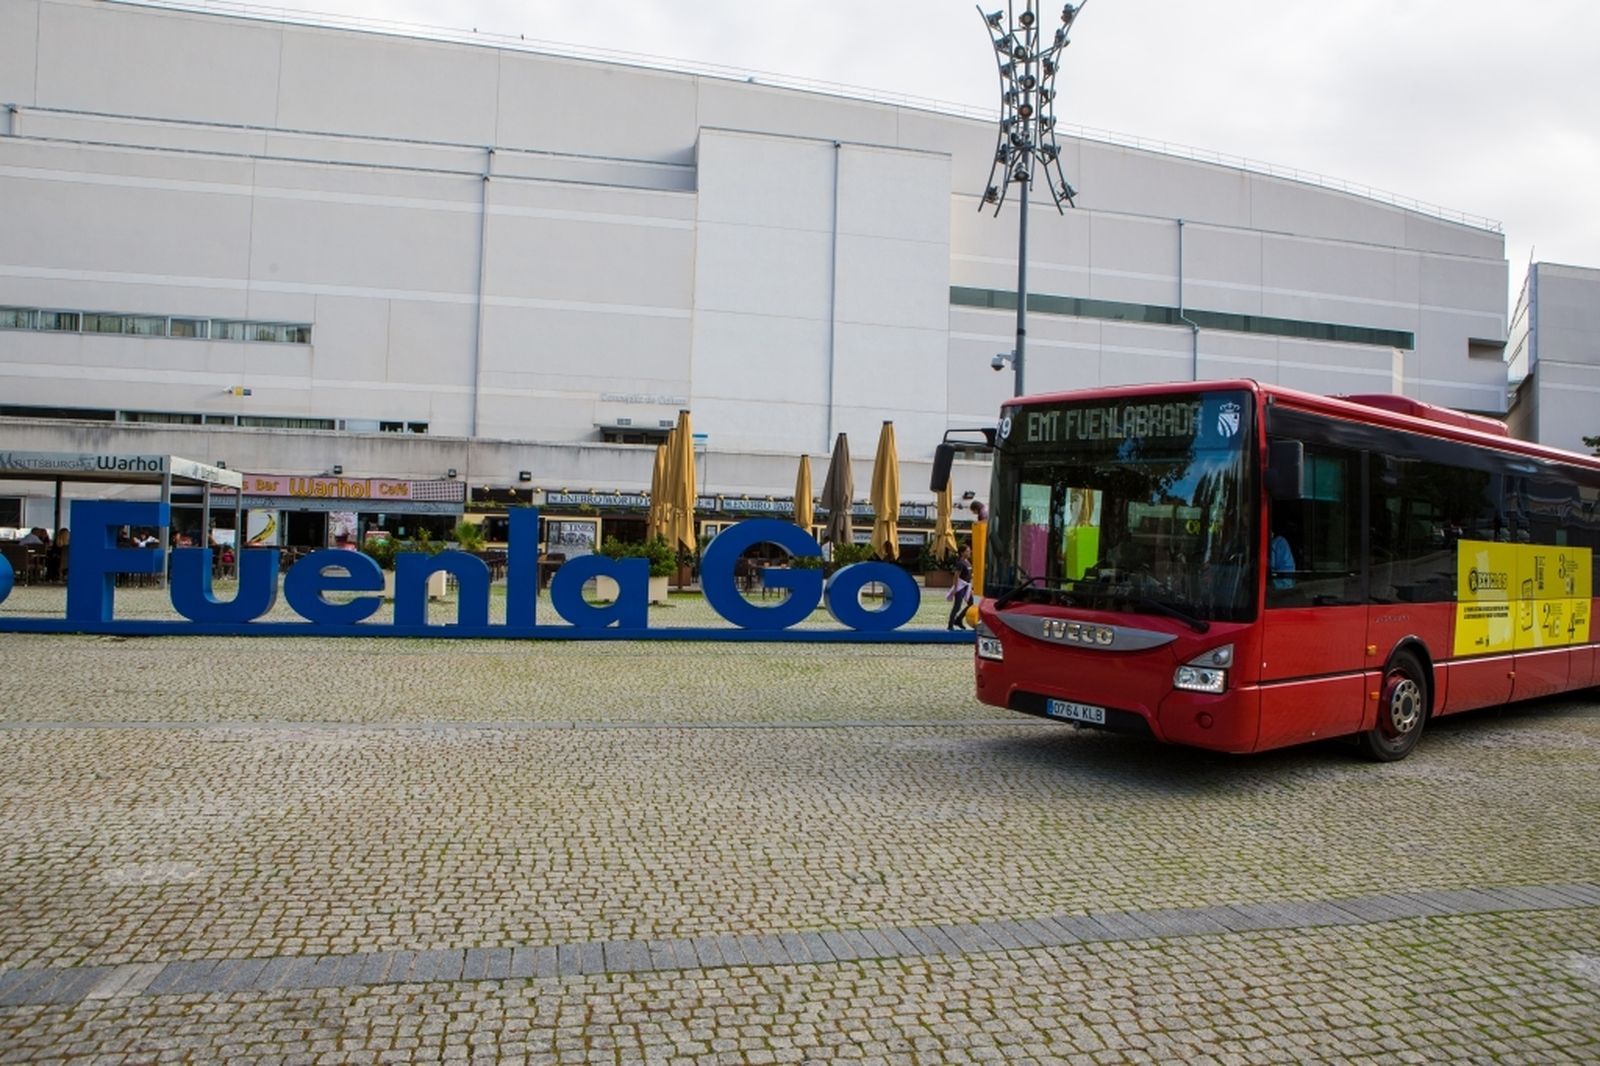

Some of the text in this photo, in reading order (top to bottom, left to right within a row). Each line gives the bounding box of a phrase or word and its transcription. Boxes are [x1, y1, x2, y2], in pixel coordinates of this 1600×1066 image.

[1027, 402, 1203, 442] EMT FUENLABRADA
[97, 455, 164, 472] Warhol
[255, 479, 279, 492] Bar
[289, 478, 371, 498] Warhol
[1043, 619, 1114, 645] IVECO
[1054, 702, 1103, 721] 0764 KLB
